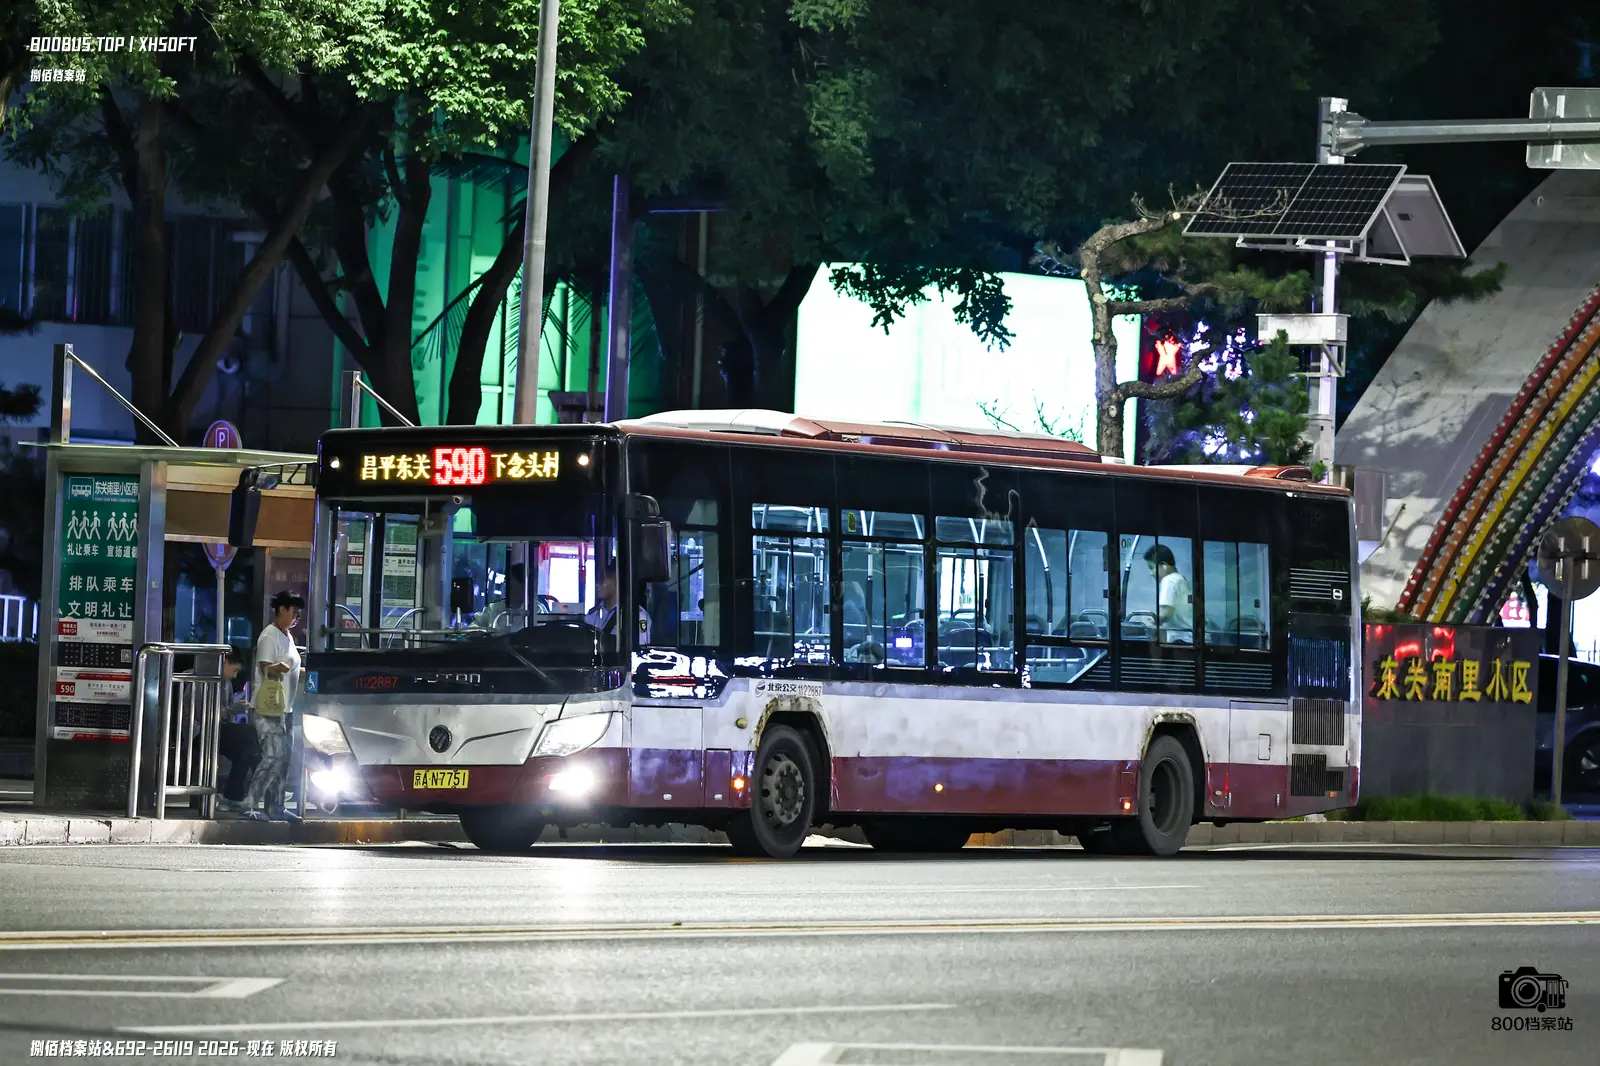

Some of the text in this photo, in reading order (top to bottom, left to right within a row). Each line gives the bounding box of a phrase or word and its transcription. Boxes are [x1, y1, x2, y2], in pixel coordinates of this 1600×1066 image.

[362, 448, 559, 484] 昌平东关 590 下念头村
[67, 543, 99, 556] 礼让乘车
[69, 575, 134, 593] 排队乘车
[68, 600, 132, 618] 文明礼让
[355, 676, 399, 689] 1122887
[767, 682, 797, 692] 北京公交
[1377, 655, 1533, 704] 东关南里小区
[60, 684, 75, 693] 590
